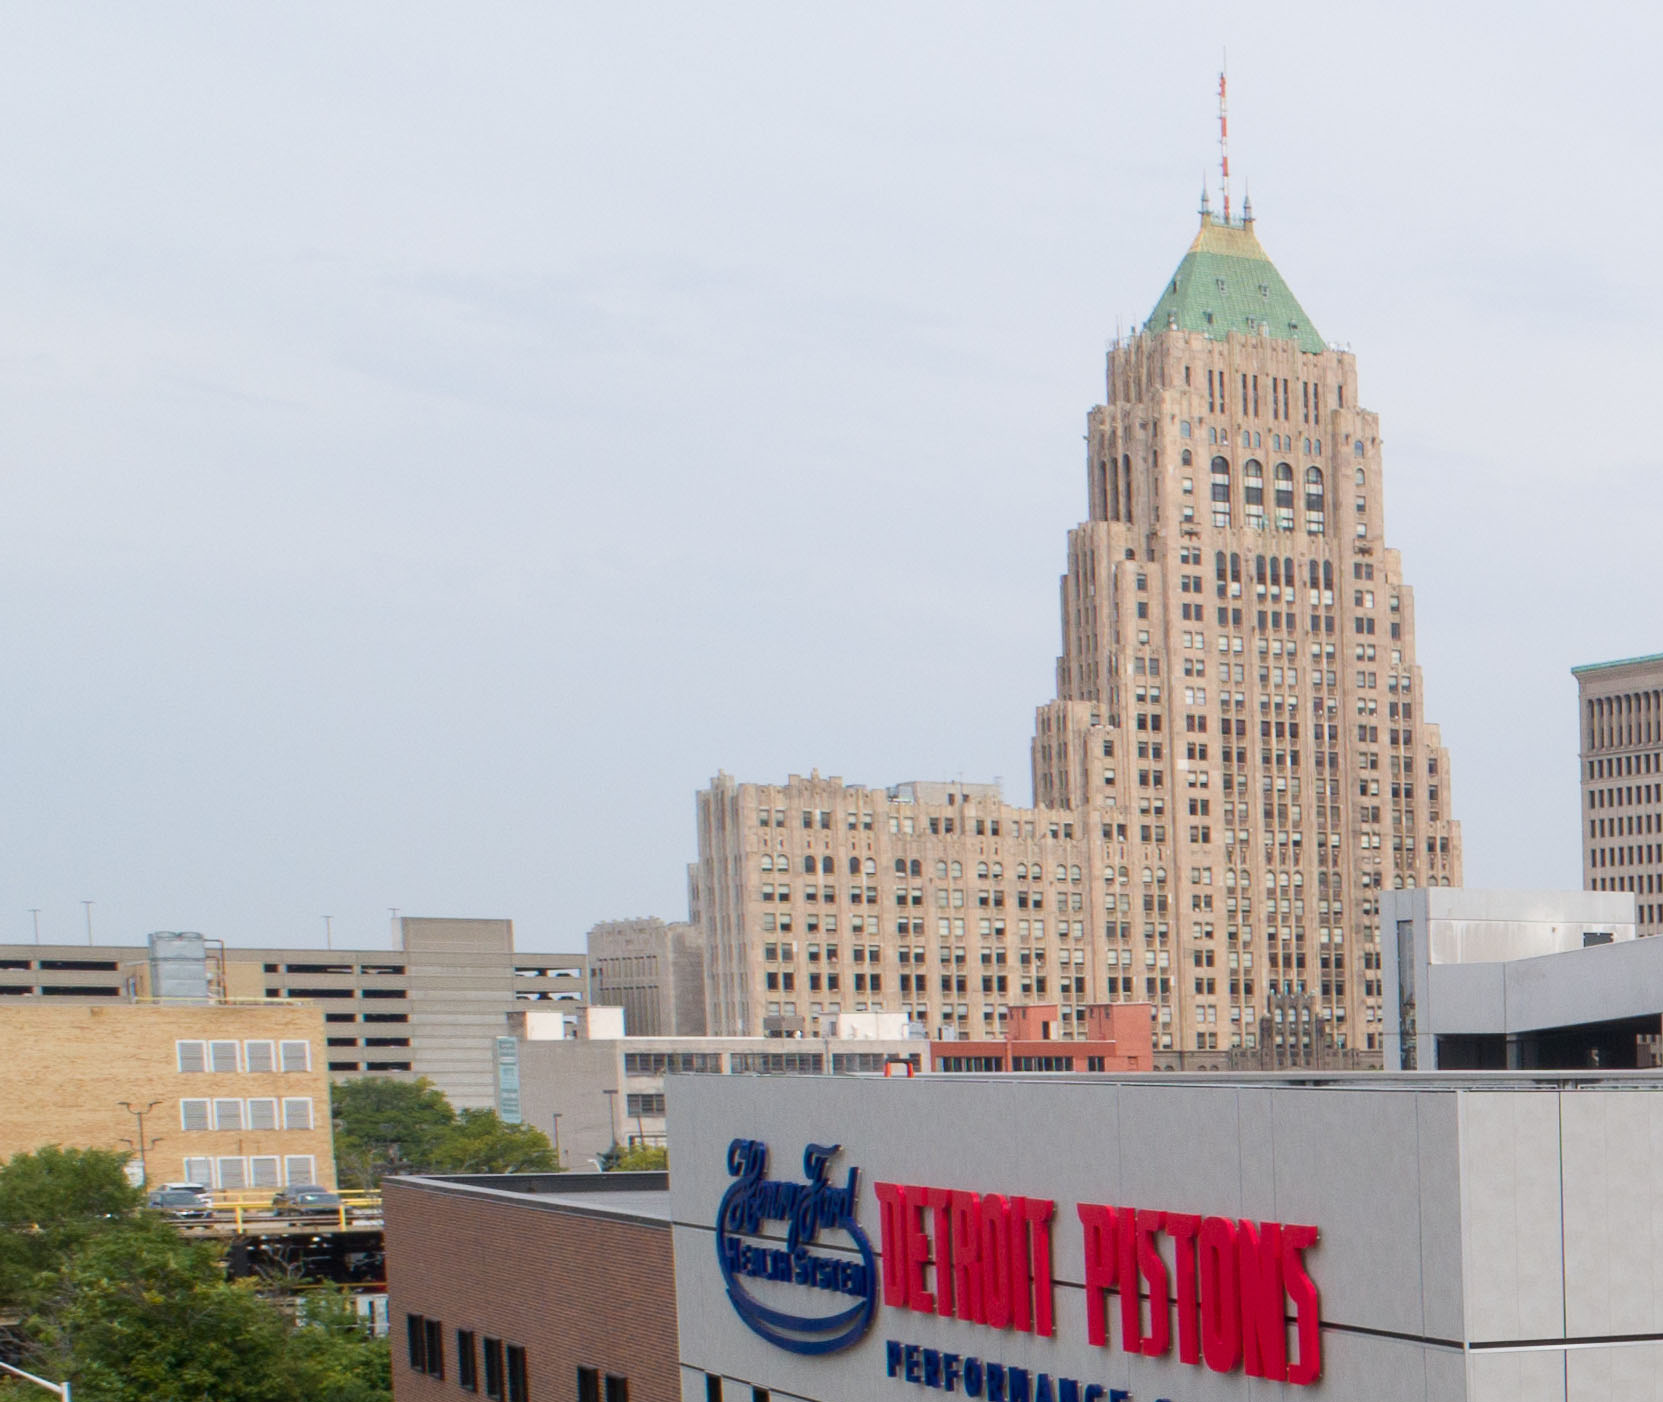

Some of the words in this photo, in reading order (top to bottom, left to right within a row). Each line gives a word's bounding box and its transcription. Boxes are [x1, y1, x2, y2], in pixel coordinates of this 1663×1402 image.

[724, 1138, 803, 1252] Henry
[797, 1143, 861, 1243] Ford
[874, 1181, 1054, 1338] DETROIT
[1077, 1202, 1321, 1387] PISTONS
